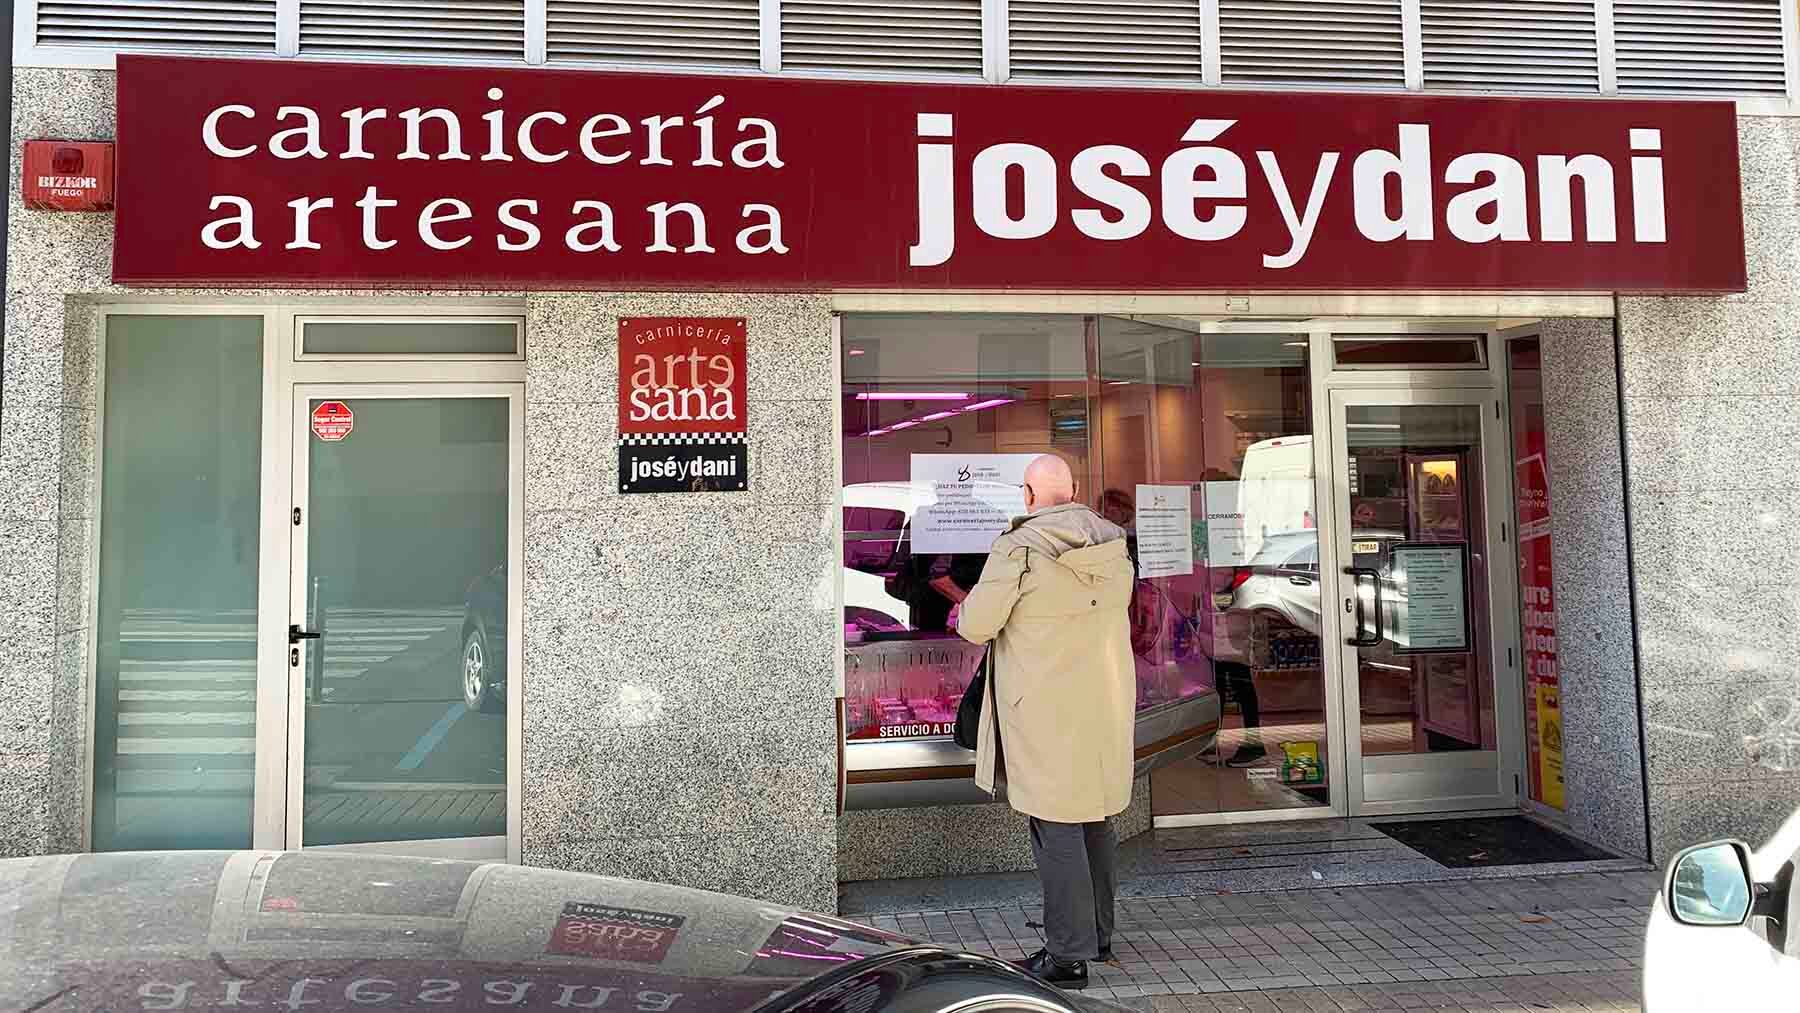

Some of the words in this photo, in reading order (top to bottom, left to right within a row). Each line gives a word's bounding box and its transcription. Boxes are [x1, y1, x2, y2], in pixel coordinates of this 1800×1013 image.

[202, 87, 785, 169] carnicería
[39, 175, 97, 189] BIZKOR
[52, 189, 82, 197] FUEGO
[201, 186, 790, 254] artesana
[635, 322, 731, 345] carnicería
[630, 388, 737, 422] sana
[879, 724, 930, 738] SERVICIO
[932, 723, 941, 735] A
